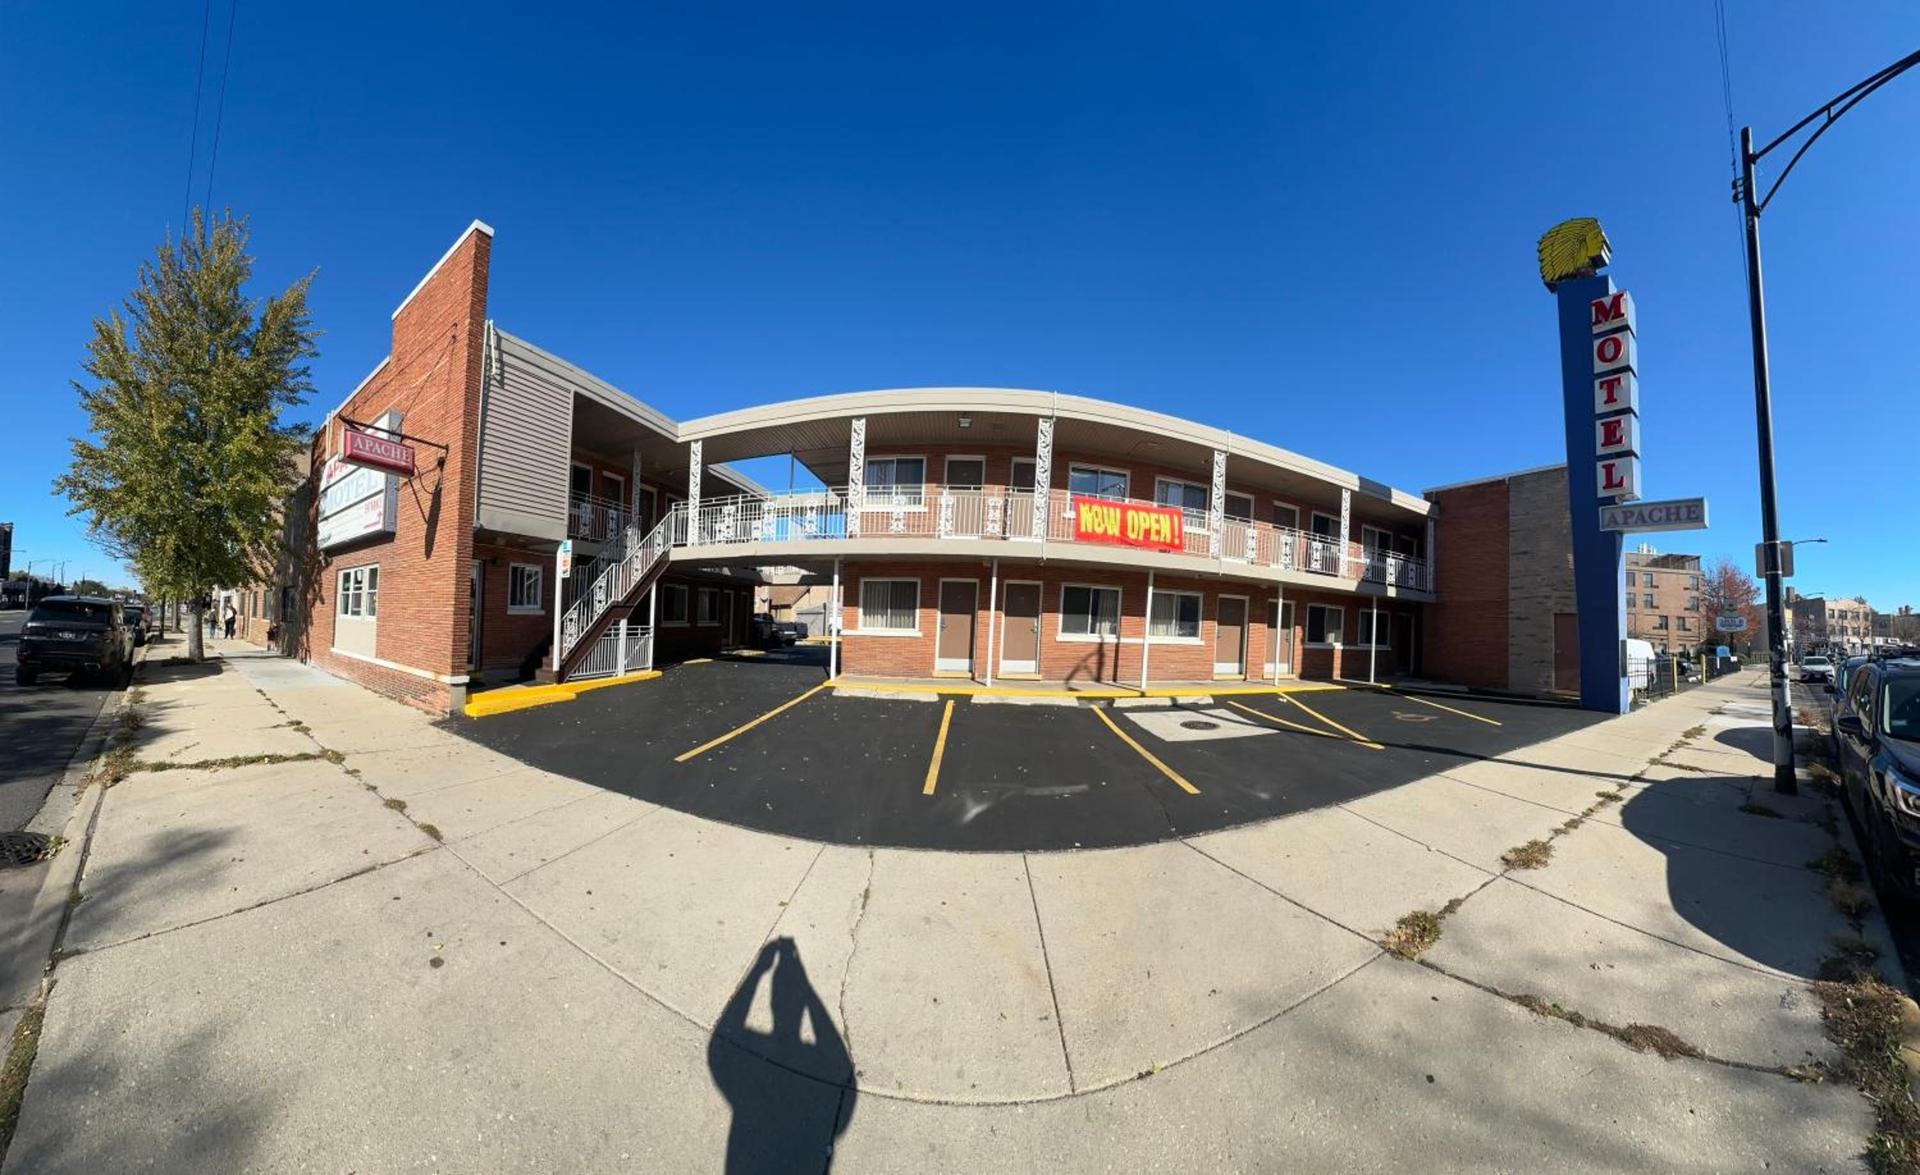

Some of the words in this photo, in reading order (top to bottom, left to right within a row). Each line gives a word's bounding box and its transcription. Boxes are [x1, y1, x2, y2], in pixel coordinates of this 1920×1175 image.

[1591, 290, 1626, 490] MOTEL
[353, 436, 411, 462] APACHE
[1078, 502, 1121, 537] NOW
[1607, 503, 1700, 528] APACHE
